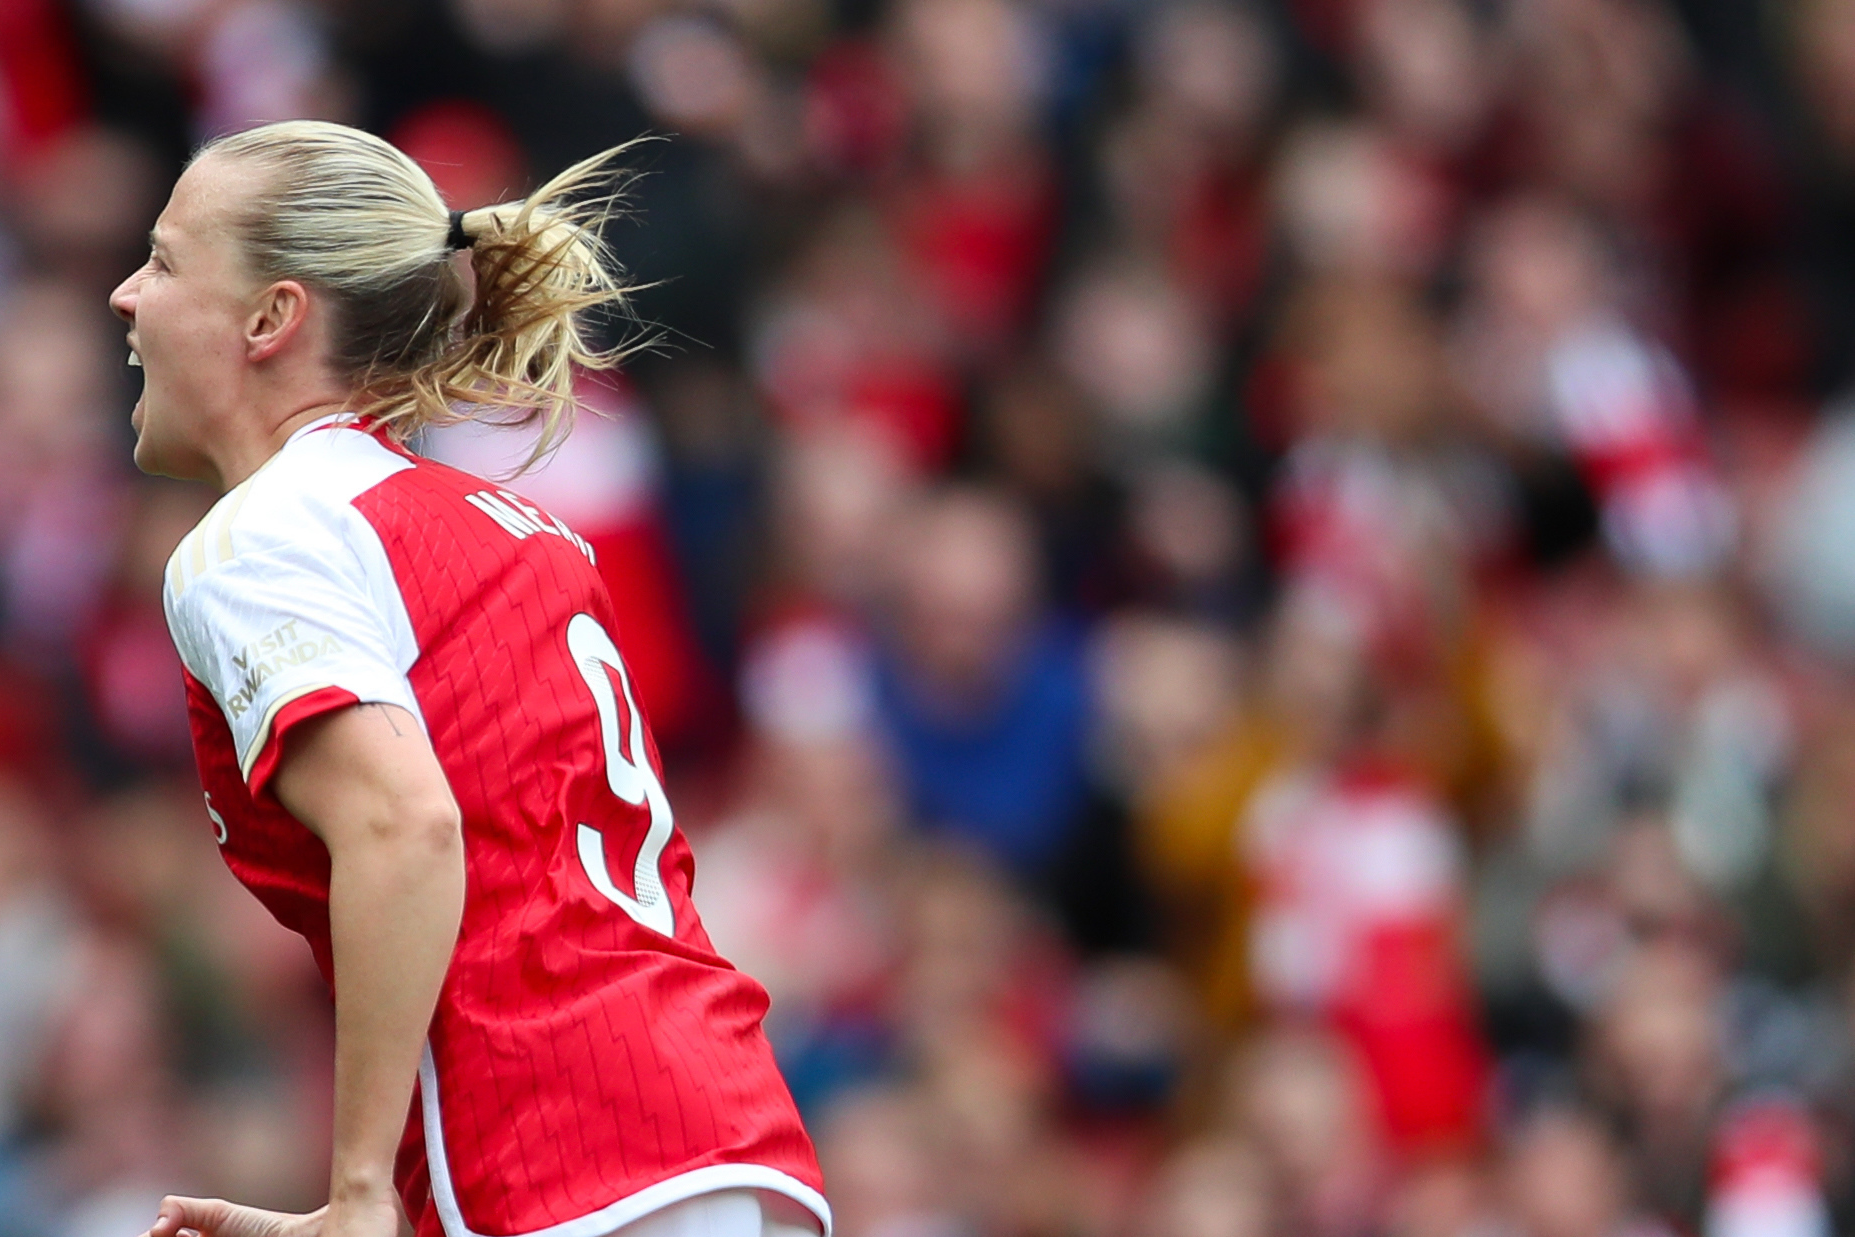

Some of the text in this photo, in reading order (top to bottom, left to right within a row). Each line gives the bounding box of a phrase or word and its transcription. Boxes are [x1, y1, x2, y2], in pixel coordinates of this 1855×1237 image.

[226, 634, 344, 720] RWANDA
[232, 619, 299, 671] VISIT
[566, 611, 675, 938] 9
